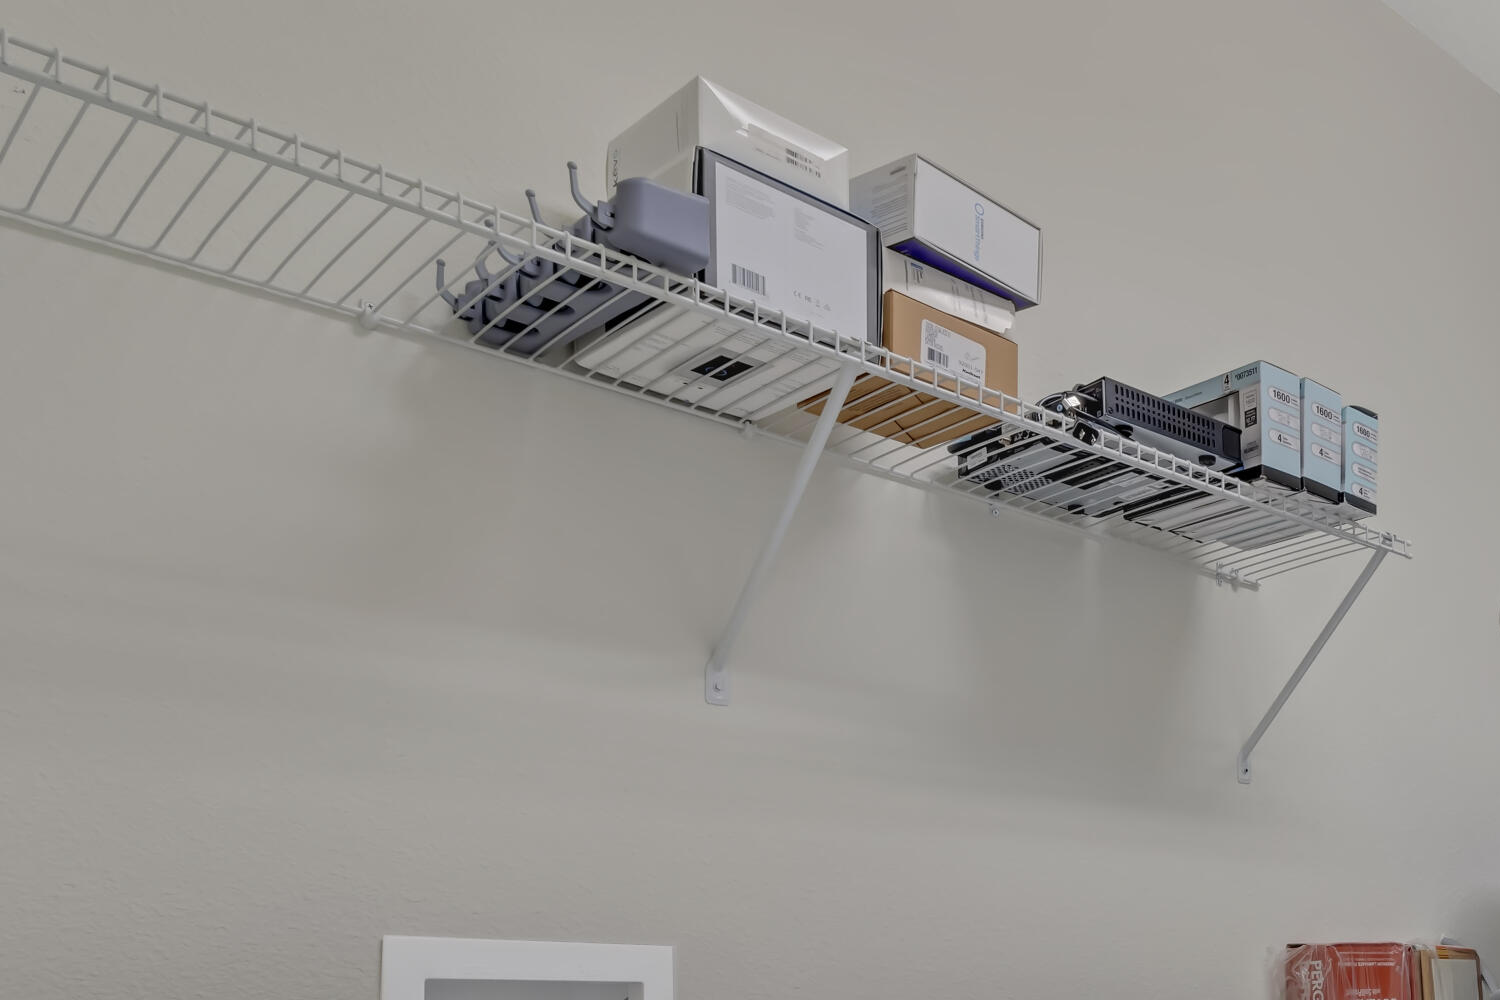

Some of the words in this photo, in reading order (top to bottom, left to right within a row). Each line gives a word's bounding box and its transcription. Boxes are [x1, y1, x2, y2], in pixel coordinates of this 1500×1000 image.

[1223, 374, 1230, 385] 4
[1272, 389, 1291, 404] 1600
[1315, 405, 1333, 420] 1600
[1356, 425, 1371, 438] 1600
[1277, 434, 1282, 443] 4
[1318, 448, 1324, 456] 4
[1358, 487, 1364, 495] 4
